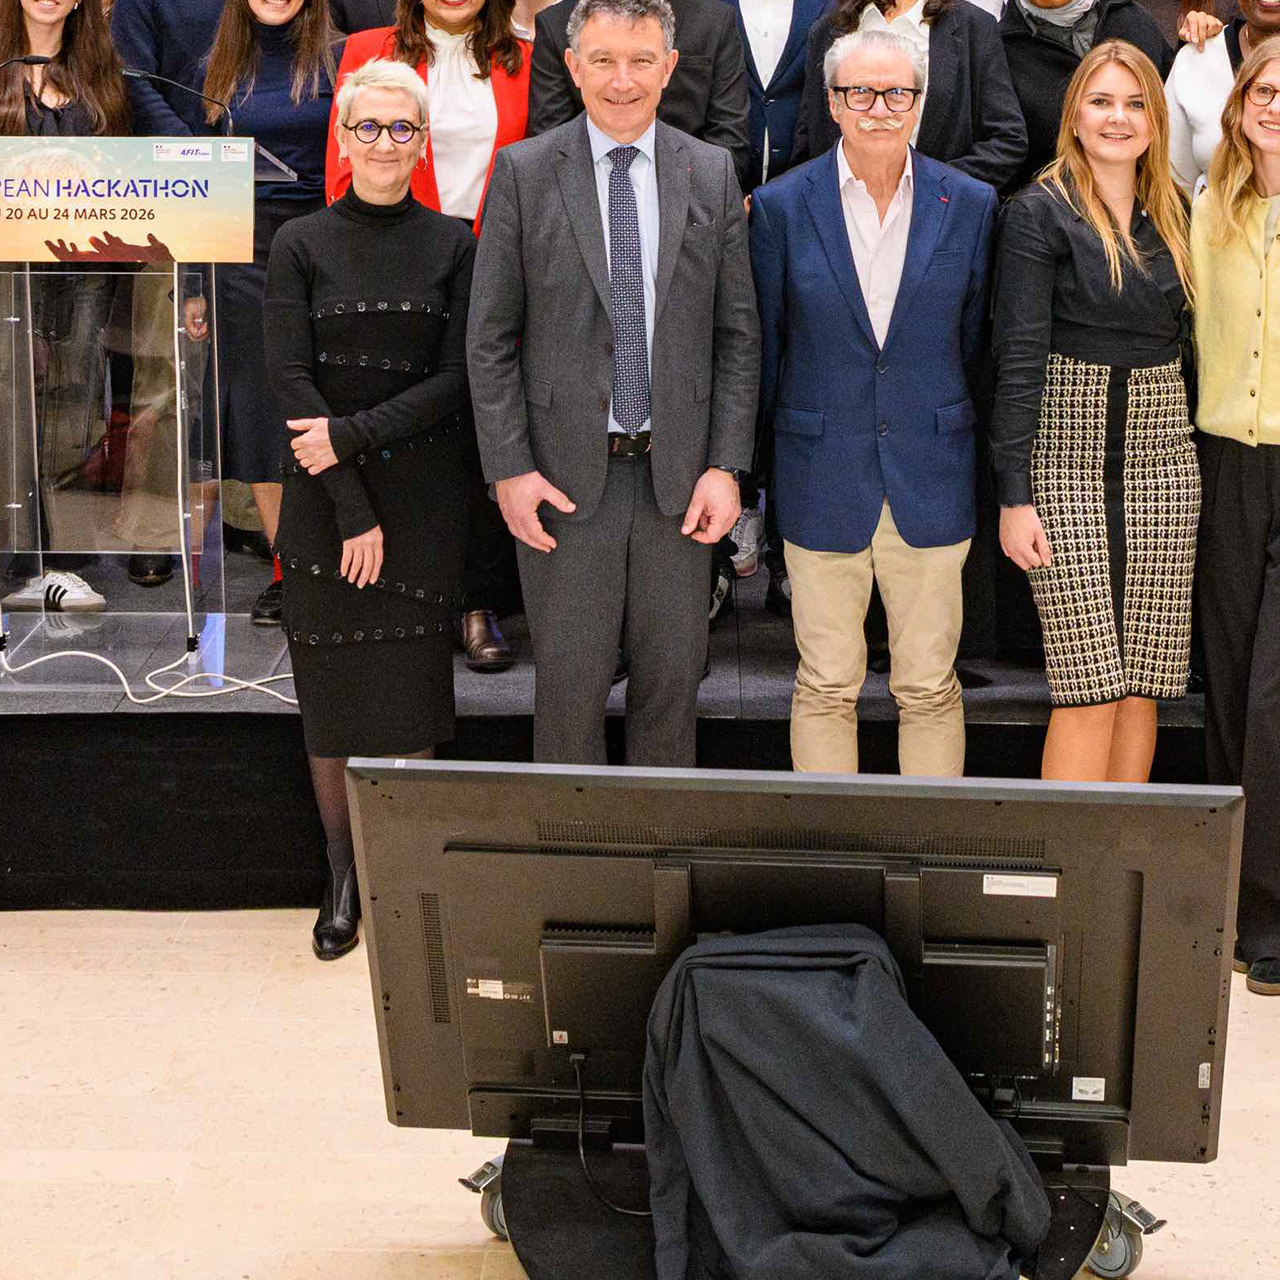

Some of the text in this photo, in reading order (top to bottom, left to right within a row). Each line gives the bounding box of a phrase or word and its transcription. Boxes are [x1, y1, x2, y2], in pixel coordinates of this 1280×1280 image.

[56, 179, 208, 198] HACKATHON
[5, 208, 23, 220] 20
[27, 208, 49, 220] AU
[53, 208, 69, 220] 24
[74, 208, 116, 220] MARS
[120, 208, 155, 220] 2026
